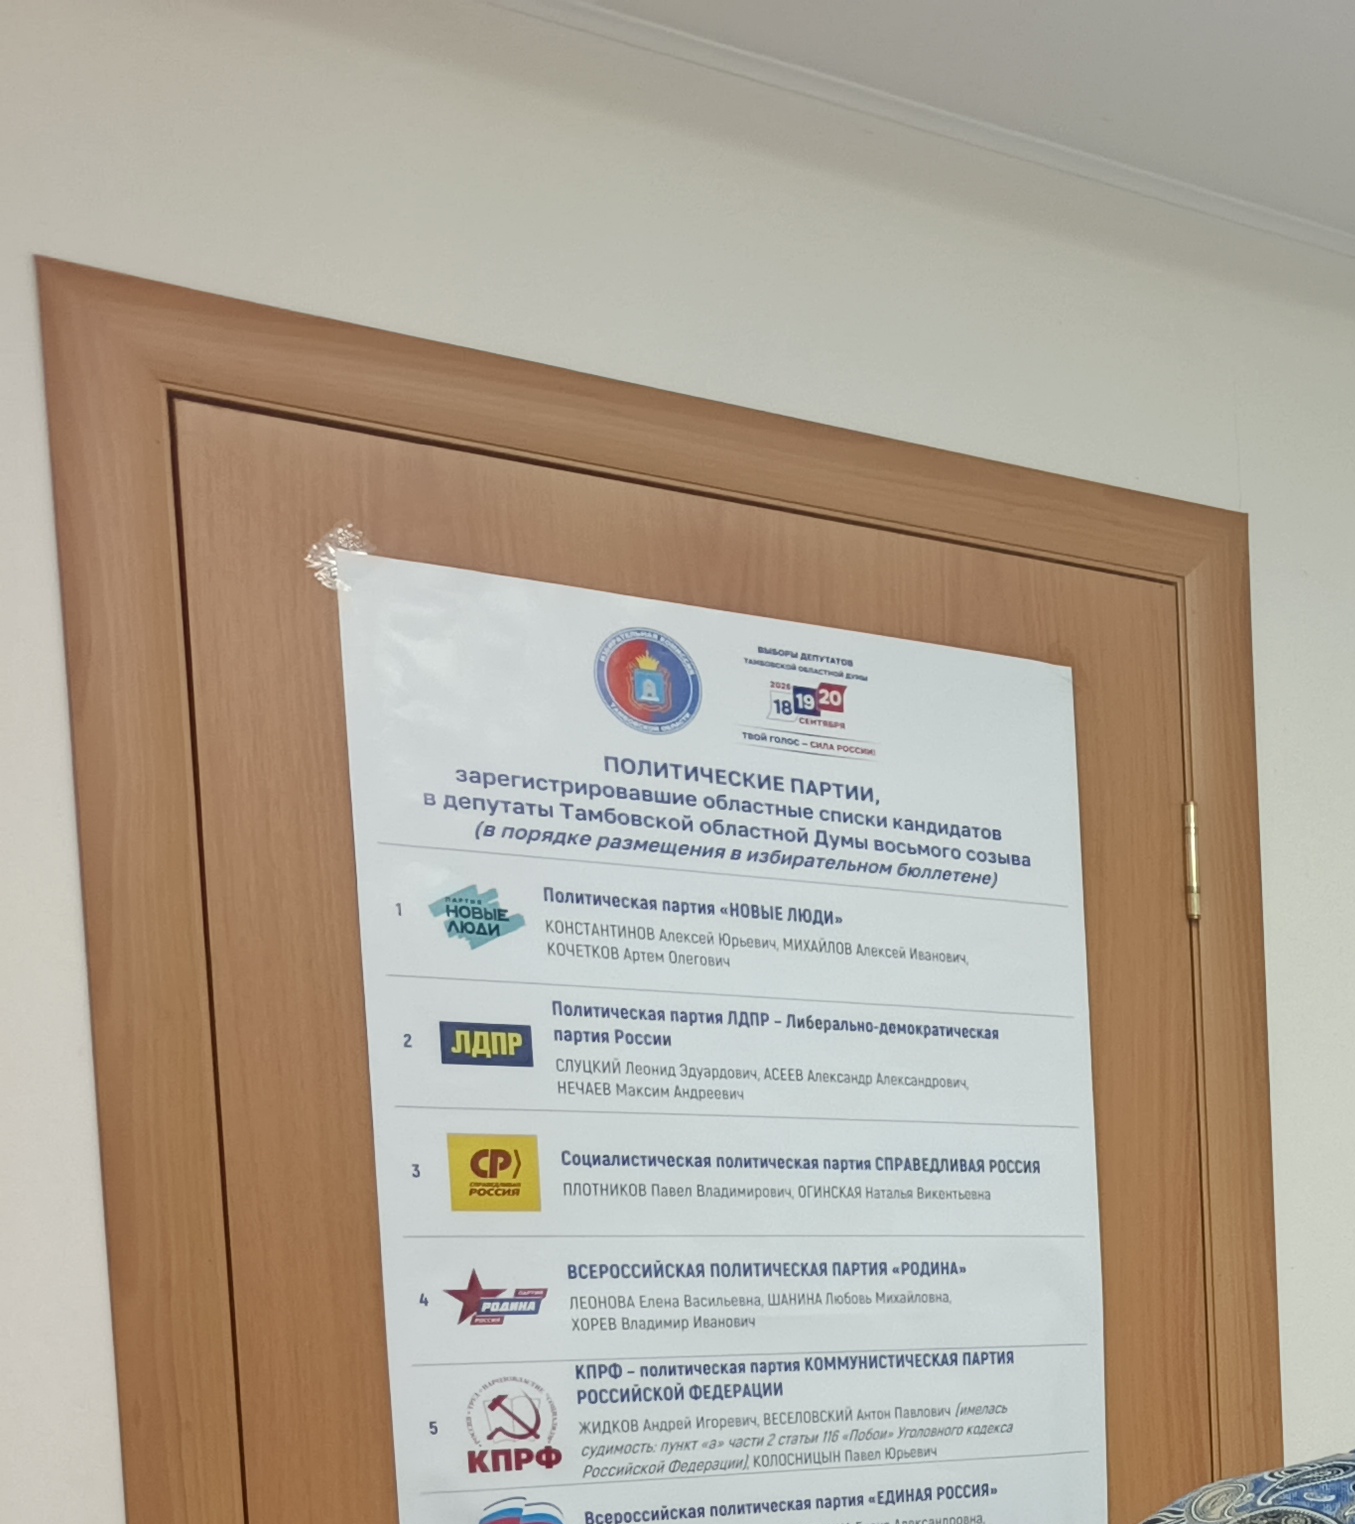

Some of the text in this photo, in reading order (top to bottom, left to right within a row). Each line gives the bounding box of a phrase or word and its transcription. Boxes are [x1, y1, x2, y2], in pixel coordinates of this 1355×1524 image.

[758, 646, 853, 666] ВЫБОРЫ ДЕПУТАТОВ
[773, 689, 842, 716] 18 19 20
[798, 717, 846, 729] СЕНТЯБРЯ
[742, 732, 767, 741] ТВОЙ
[770, 736, 799, 746] ГОЛОС
[810, 741, 834, 750] СИЛА
[837, 745, 875, 755] РОССИИ!
[603, 755, 880, 806] ПОЛИТИЧЕСКИЕ ПАРТИИ,
[455, 769, 1002, 841] зарегистрировавшие областные списки кандидатов
[423, 792, 1031, 867] в депутаты Тамбовской областной Думы восьмого созыва
[474, 820, 998, 889] (в порядке размещения в избирательном бюллетене)
[395, 902, 402, 917] 1
[446, 904, 510, 922] НОВЫЕ
[543, 886, 843, 926] Политическая партия «НОВЫЕ ЛЮДИ»
[447, 921, 501, 937] ЛЮДИ
[545, 919, 969, 966] КОНСТАНТИНОВ Алексей Юрьевич, МИХАЙЛОВ Алексей Иванович,
[551, 1000, 665, 1022] Политическая
[670, 1010, 723, 1027] партия
[727, 1010, 770, 1028] ЛДПР
[785, 1013, 999, 1040] Либерально-демократическая
[403, 1033, 412, 1048] 2
[451, 1030, 523, 1058] ЛДПР
[553, 1028, 672, 1046] партия России
[411, 1163, 421, 1178] 3
[561, 1149, 1040, 1174] Социалистическая политическая партия СПРАВЕДЛИВАЯ РОССИЯ
[469, 1188, 520, 1197] РОССИЯ
[562, 1182, 991, 1201] ПЛОТНИКОВ Павел Владимирович, ОГИНСКАЯ Наталья Викентьевна
[567, 1259, 966, 1280] ВСЕРОССИЙСКАЯ ПОЛИТИЧЕСКАЯ ПАРТИЯ «РОДИНА»
[418, 1292, 429, 1306] 4
[481, 1300, 536, 1313] РОДИНА
[575, 1362, 623, 1380] КПРФ
[639, 1362, 746, 1377] политическая
[749, 1360, 800, 1376] партия
[804, 1352, 958, 1371] КОММУНИСТИЧЕСКАЯ
[962, 1350, 1014, 1366] ПАРТИЯ
[576, 1381, 783, 1405] РОССИЙСКОЙ ФЕДЕРАЦИИ
[428, 1420, 438, 1435] 5
[467, 1445, 563, 1474] КПРФ
[709, 1498, 811, 1517] политическая
[815, 1494, 864, 1511] партия
[868, 1486, 932, 1506] «ЕДИНАЯ
[936, 1482, 998, 1500] РОССИЯ»
